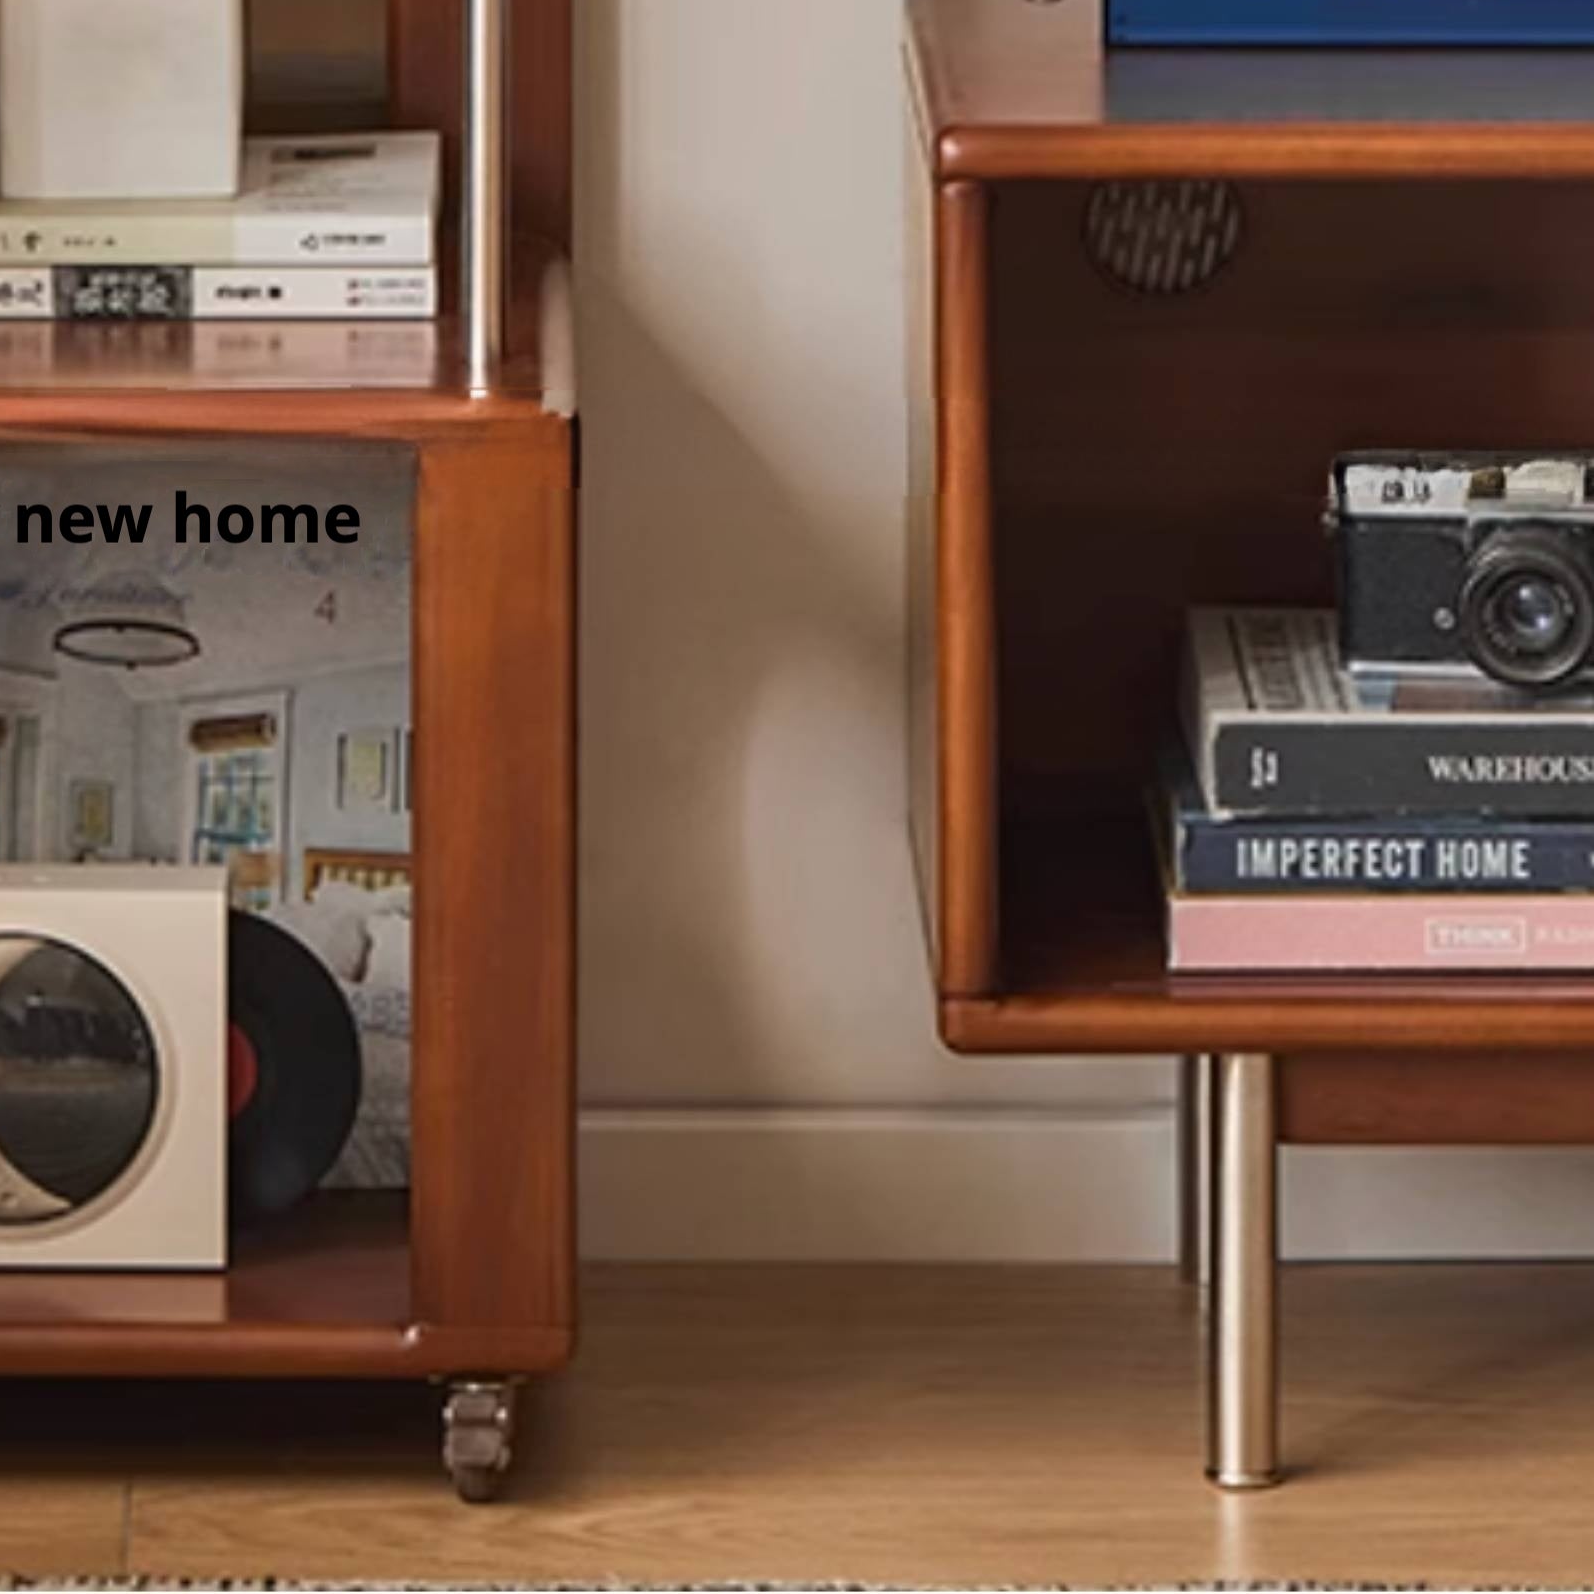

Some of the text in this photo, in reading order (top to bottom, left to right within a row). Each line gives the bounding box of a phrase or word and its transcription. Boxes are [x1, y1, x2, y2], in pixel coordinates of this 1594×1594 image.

[1428, 755, 1594, 783] WAREHOUS
[1237, 838, 1531, 879] IMPERFECT HOME
